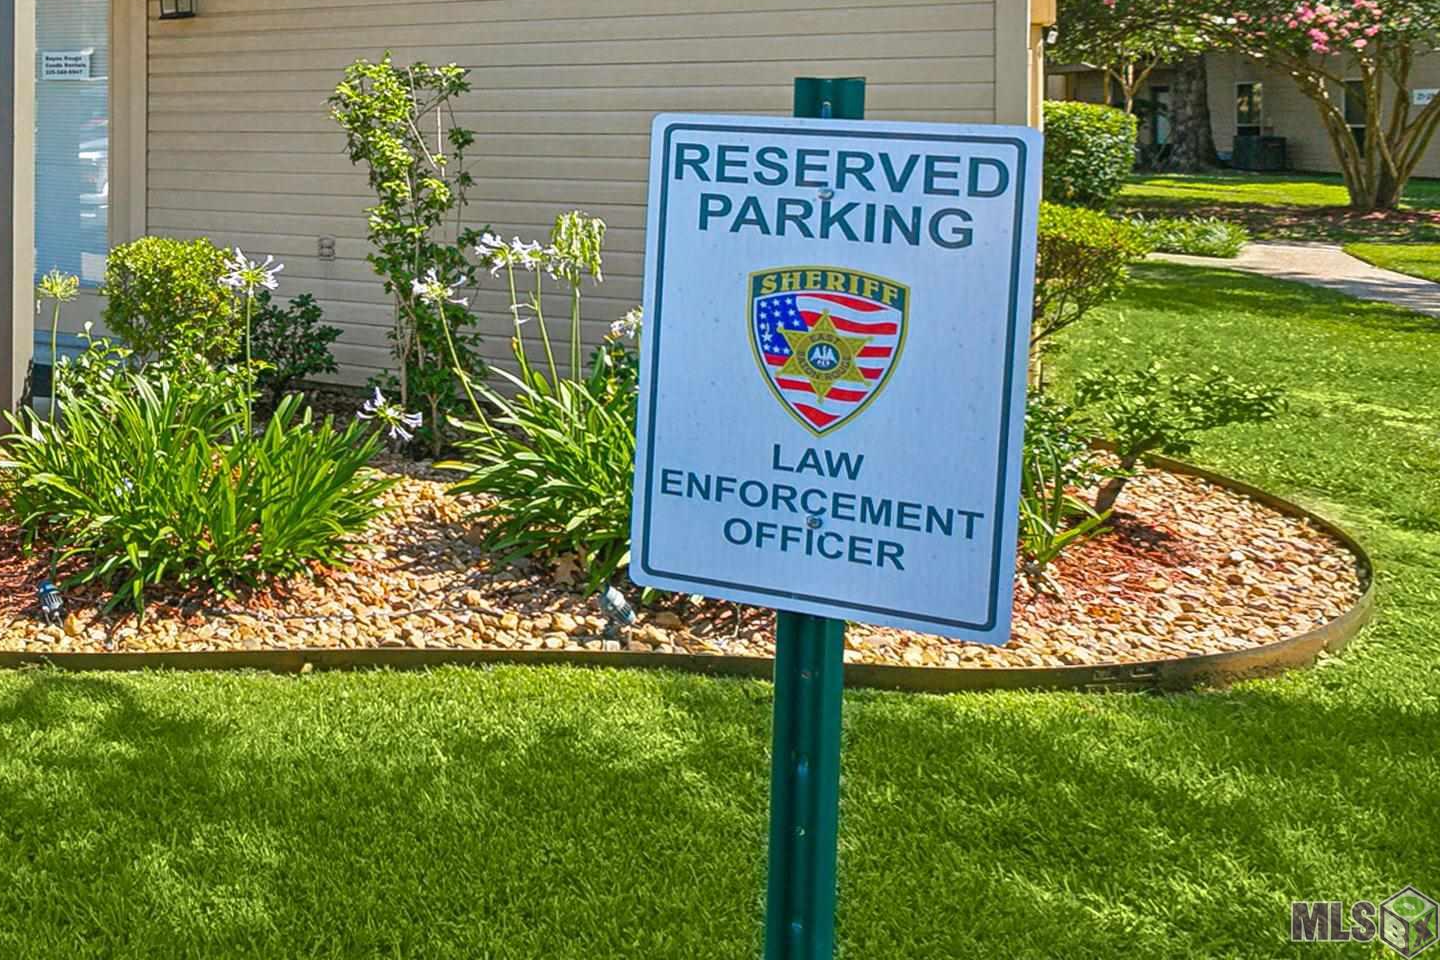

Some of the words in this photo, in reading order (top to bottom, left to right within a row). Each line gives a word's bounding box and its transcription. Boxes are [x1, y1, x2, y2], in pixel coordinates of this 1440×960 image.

[673, 142, 1010, 199] RESERVED
[698, 193, 975, 249] PARKING
[760, 271, 898, 306] SHERIFF
[772, 443, 864, 481] LAW
[661, 468, 984, 540] ENFORCEMENT
[723, 517, 905, 571] OFFICER
